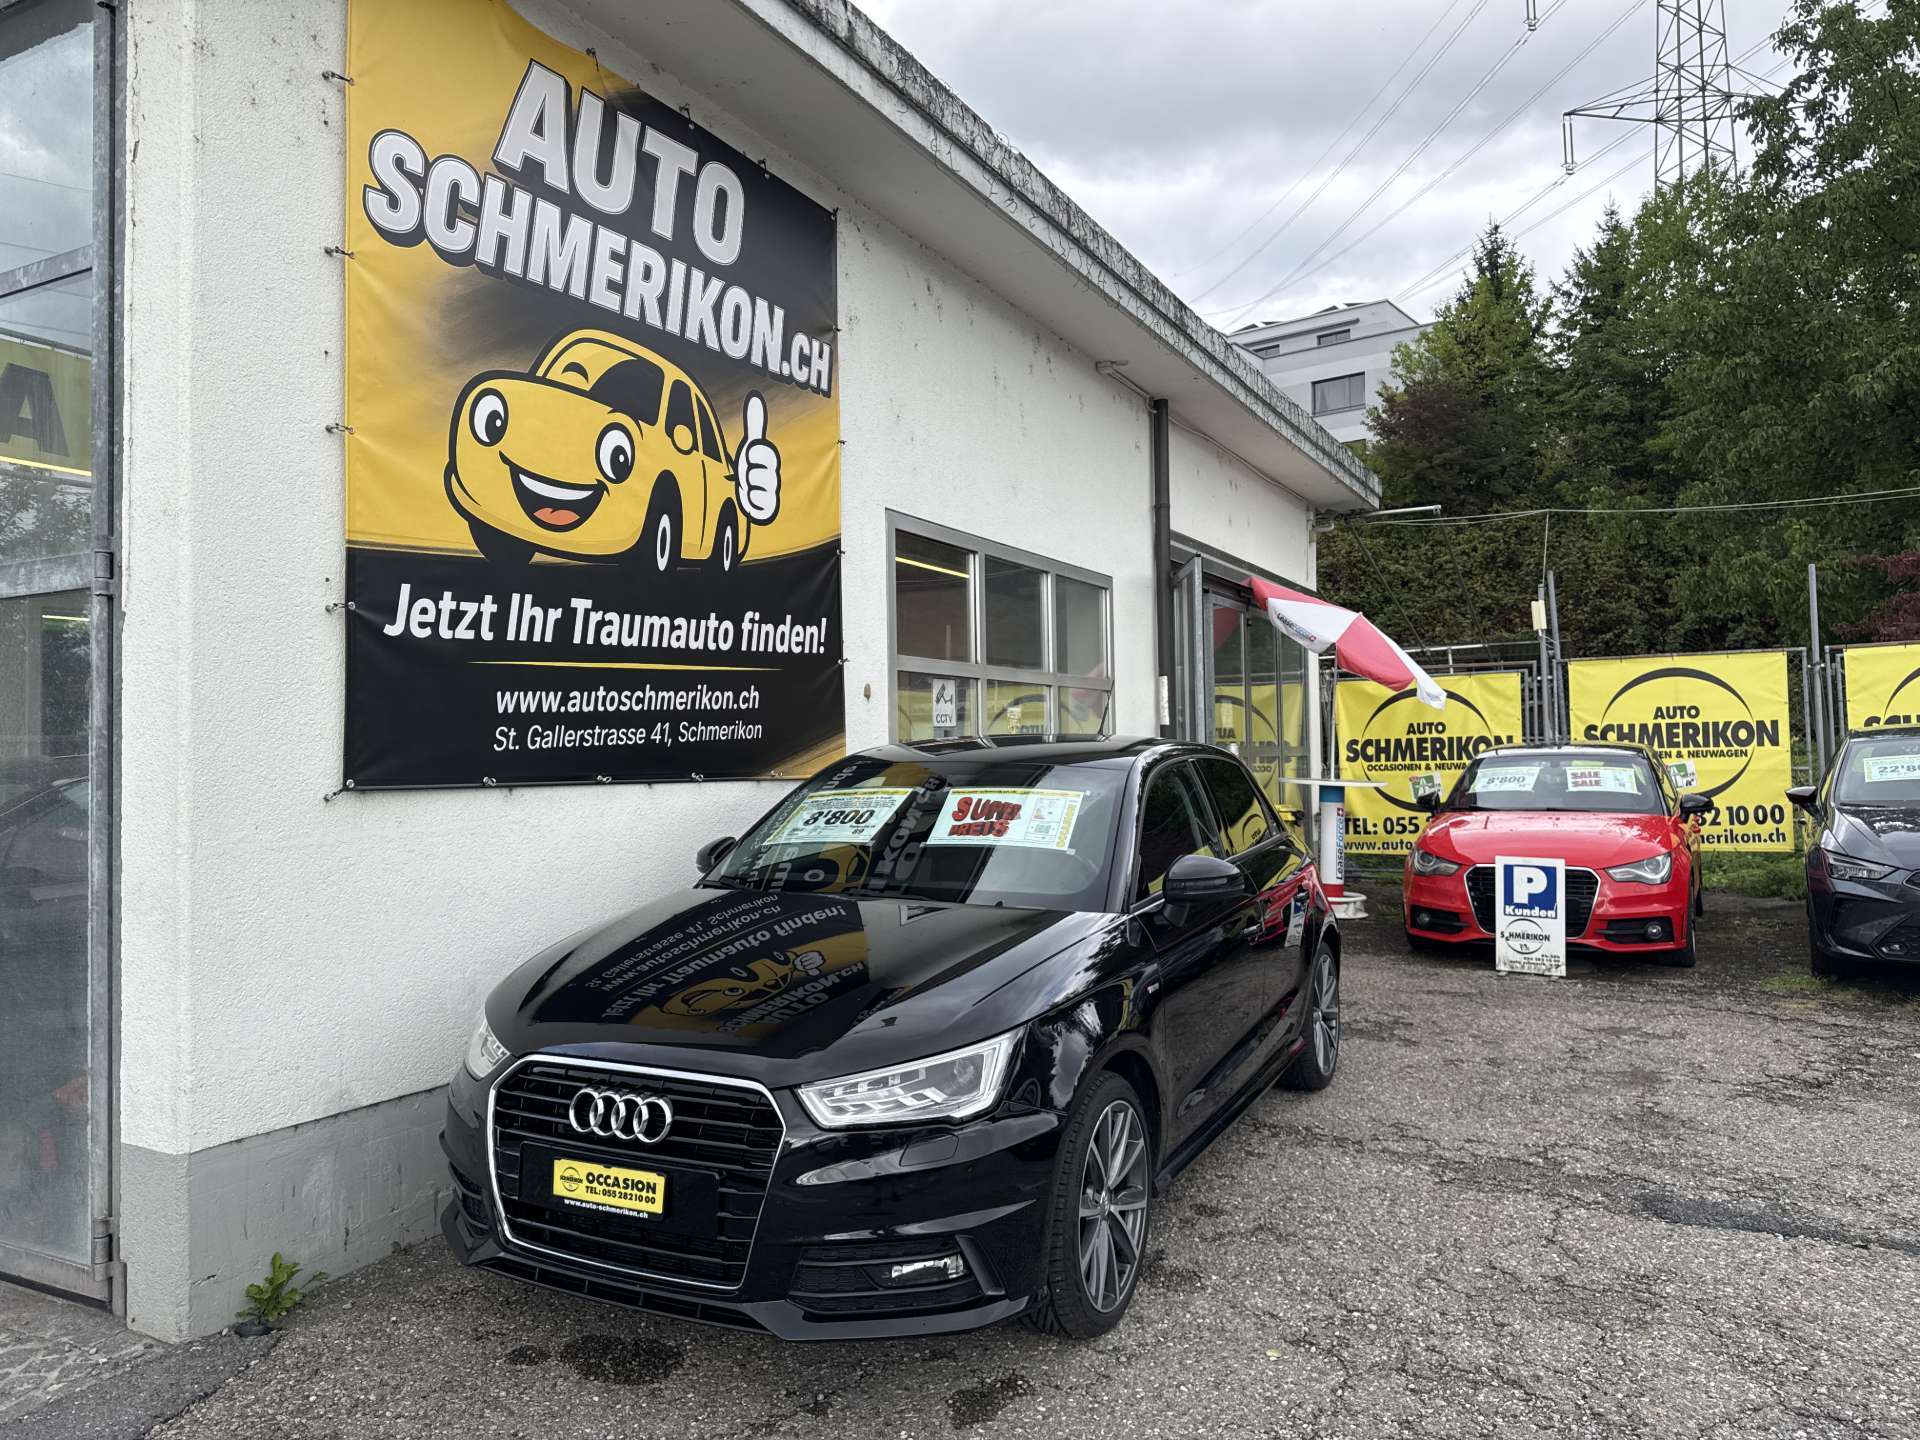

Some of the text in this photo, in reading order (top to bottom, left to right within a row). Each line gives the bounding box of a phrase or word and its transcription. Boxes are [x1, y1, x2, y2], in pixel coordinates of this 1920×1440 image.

[495, 58, 745, 266] AUTO
[364, 131, 831, 393] SCHMERIKON.CH
[383, 583, 827, 655] Jetzt Ihr Traumauto finden!
[496, 683, 760, 714] www.autoschmerikon.ch
[935, 711, 953, 724] CCTV
[1653, 705, 1700, 720] AUTO
[493, 721, 763, 752] St. Gallerstrasse 41, Schmerikon
[1406, 722, 1447, 736] AUTO
[1584, 720, 1780, 748] SCHMERIKON
[1675, 750, 1684, 759] &
[1688, 749, 1748, 758] NEUWAGEN
[1367, 762, 1467, 772] OCCASIONEN & NEUWA
[1878, 765, 1920, 774] 22'8
[803, 809, 876, 826] 8'800
[1726, 805, 1750, 826] 10
[1753, 804, 1785, 825] 00
[1345, 816, 1420, 835] TEL: 055
[1335, 817, 1344, 881] LeaseForce
[1344, 839, 1413, 851] www.auto
[1513, 866, 1548, 904] P
[1505, 904, 1556, 919] Kunden
[586, 1172, 657, 1195] OCCASION
[585, 1186, 601, 1196] TEL:
[602, 1188, 617, 1199] 055
[618, 1191, 633, 1201] 282
[644, 1196, 656, 1205] 00
